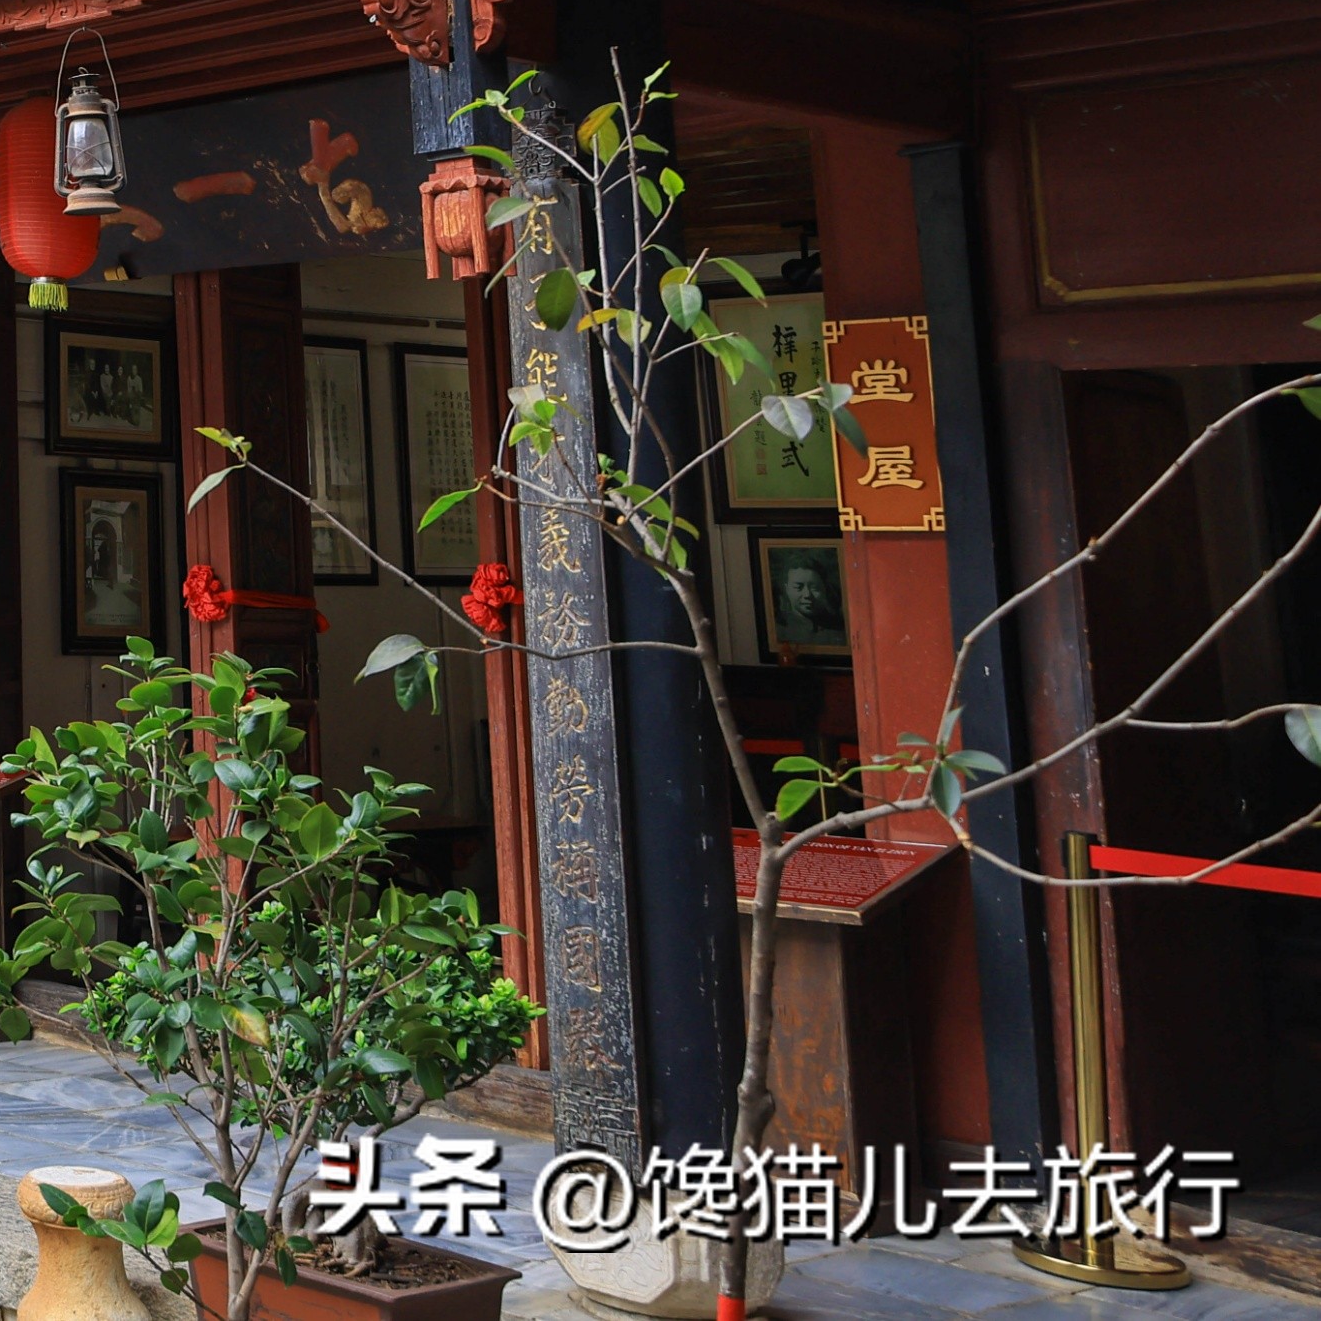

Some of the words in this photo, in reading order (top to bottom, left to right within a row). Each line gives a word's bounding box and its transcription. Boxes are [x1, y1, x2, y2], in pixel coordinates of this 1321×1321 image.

[772, 324, 810, 477] 梓里式
[849, 359, 924, 490] 堂屋
